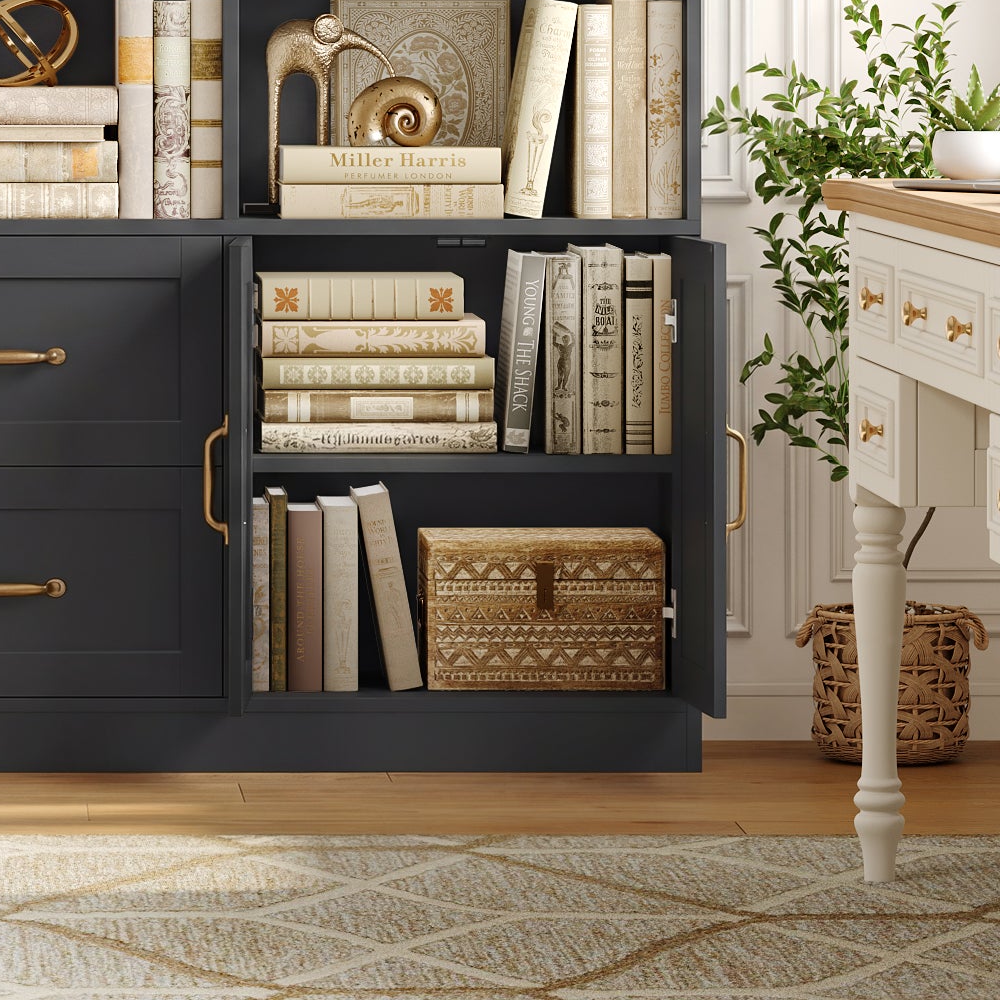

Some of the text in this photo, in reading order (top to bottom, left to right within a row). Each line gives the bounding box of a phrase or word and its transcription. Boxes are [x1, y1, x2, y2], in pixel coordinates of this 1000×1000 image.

[330, 153, 466, 167] Miller Harris
[595, 316, 615, 326] BOAT
[512, 280, 540, 412] YOUNG THE SHACK
[658, 376, 671, 415] JUMBO
